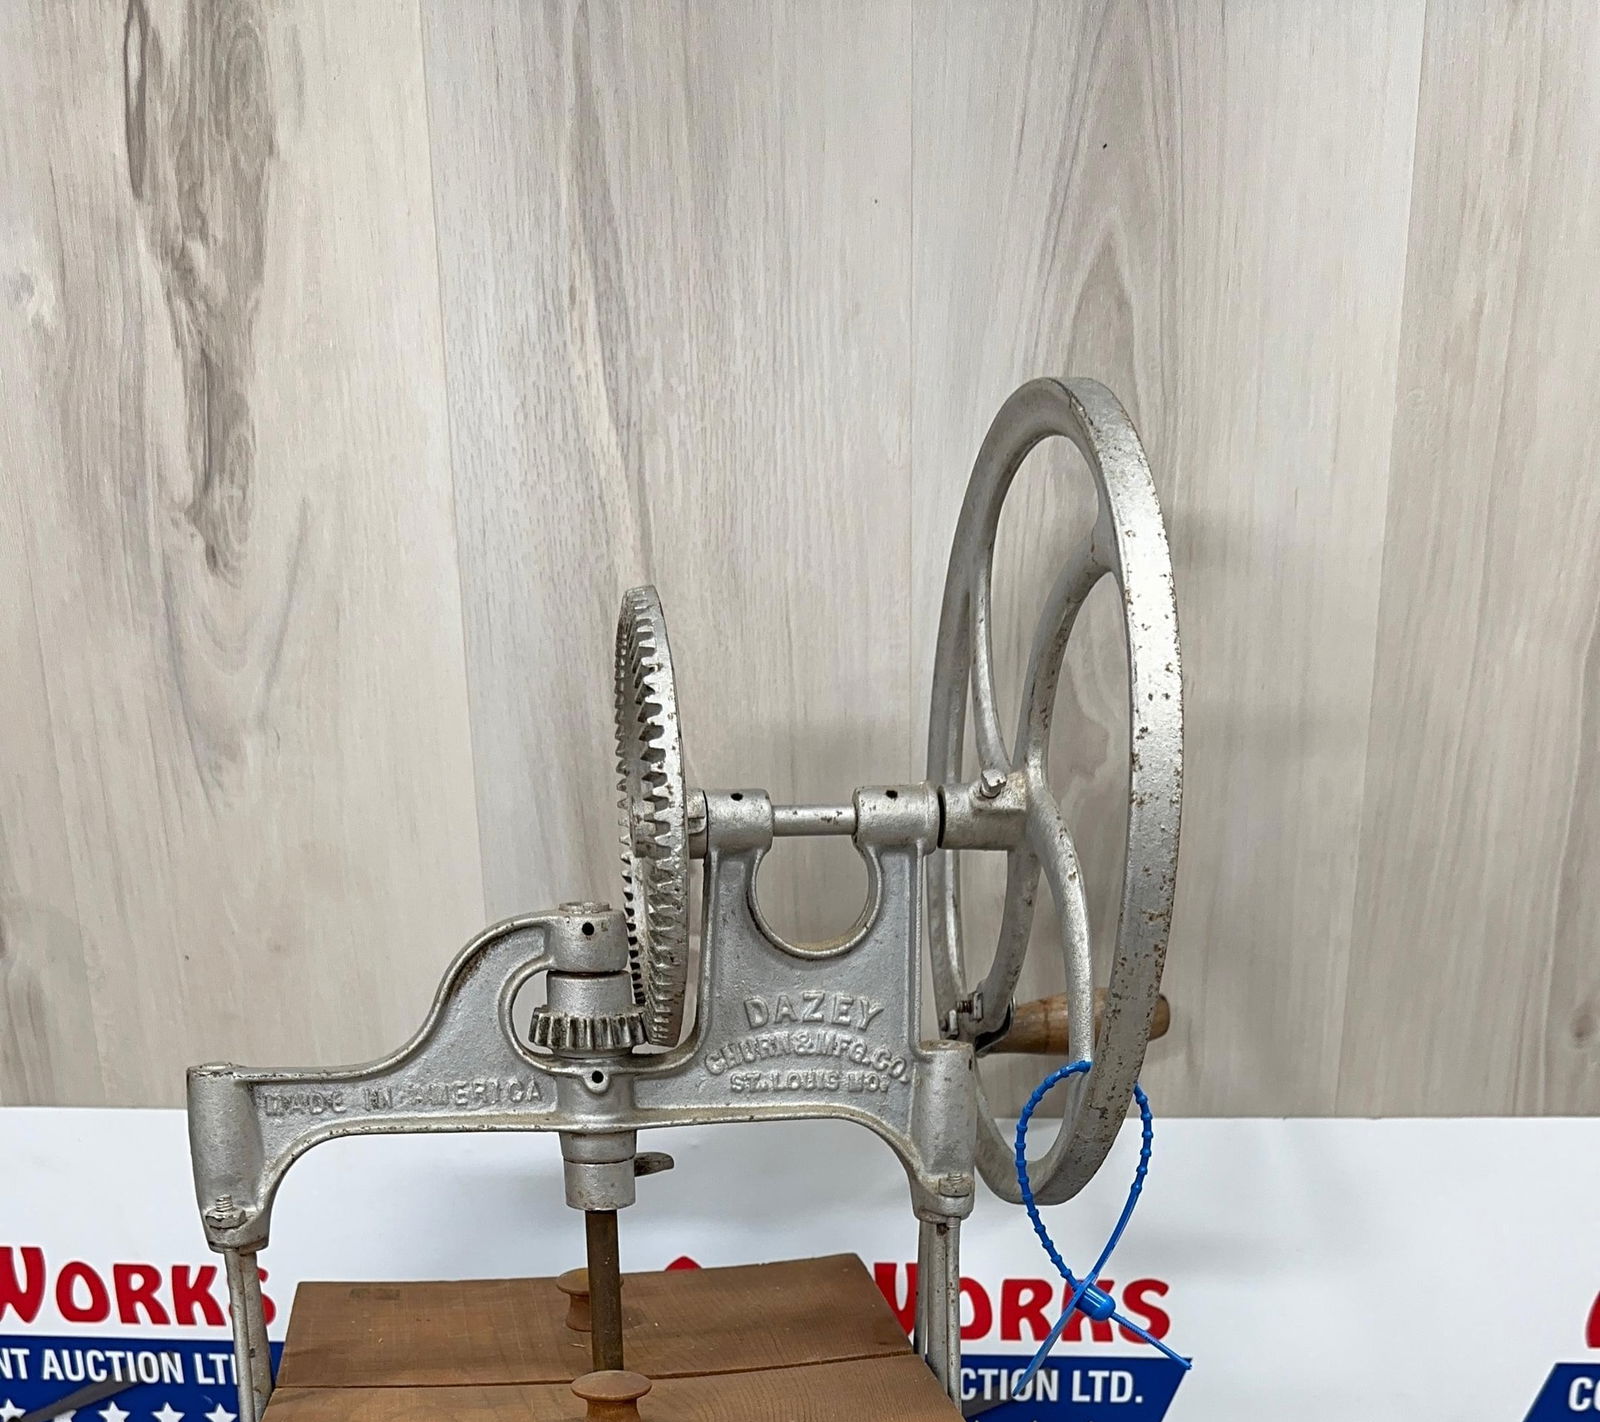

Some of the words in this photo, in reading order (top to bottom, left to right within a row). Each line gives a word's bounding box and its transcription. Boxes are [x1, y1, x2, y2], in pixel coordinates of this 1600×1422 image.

[744, 991, 884, 1031] DAZEY
[705, 1034, 792, 1075] CHURN
[770, 1070, 841, 1092] LOUIS
[42, 1348, 184, 1384] AUCTION
[194, 1352, 238, 1385] LT
[960, 1367, 1058, 1402] CTION
[1071, 1369, 1143, 1403] LTD.
